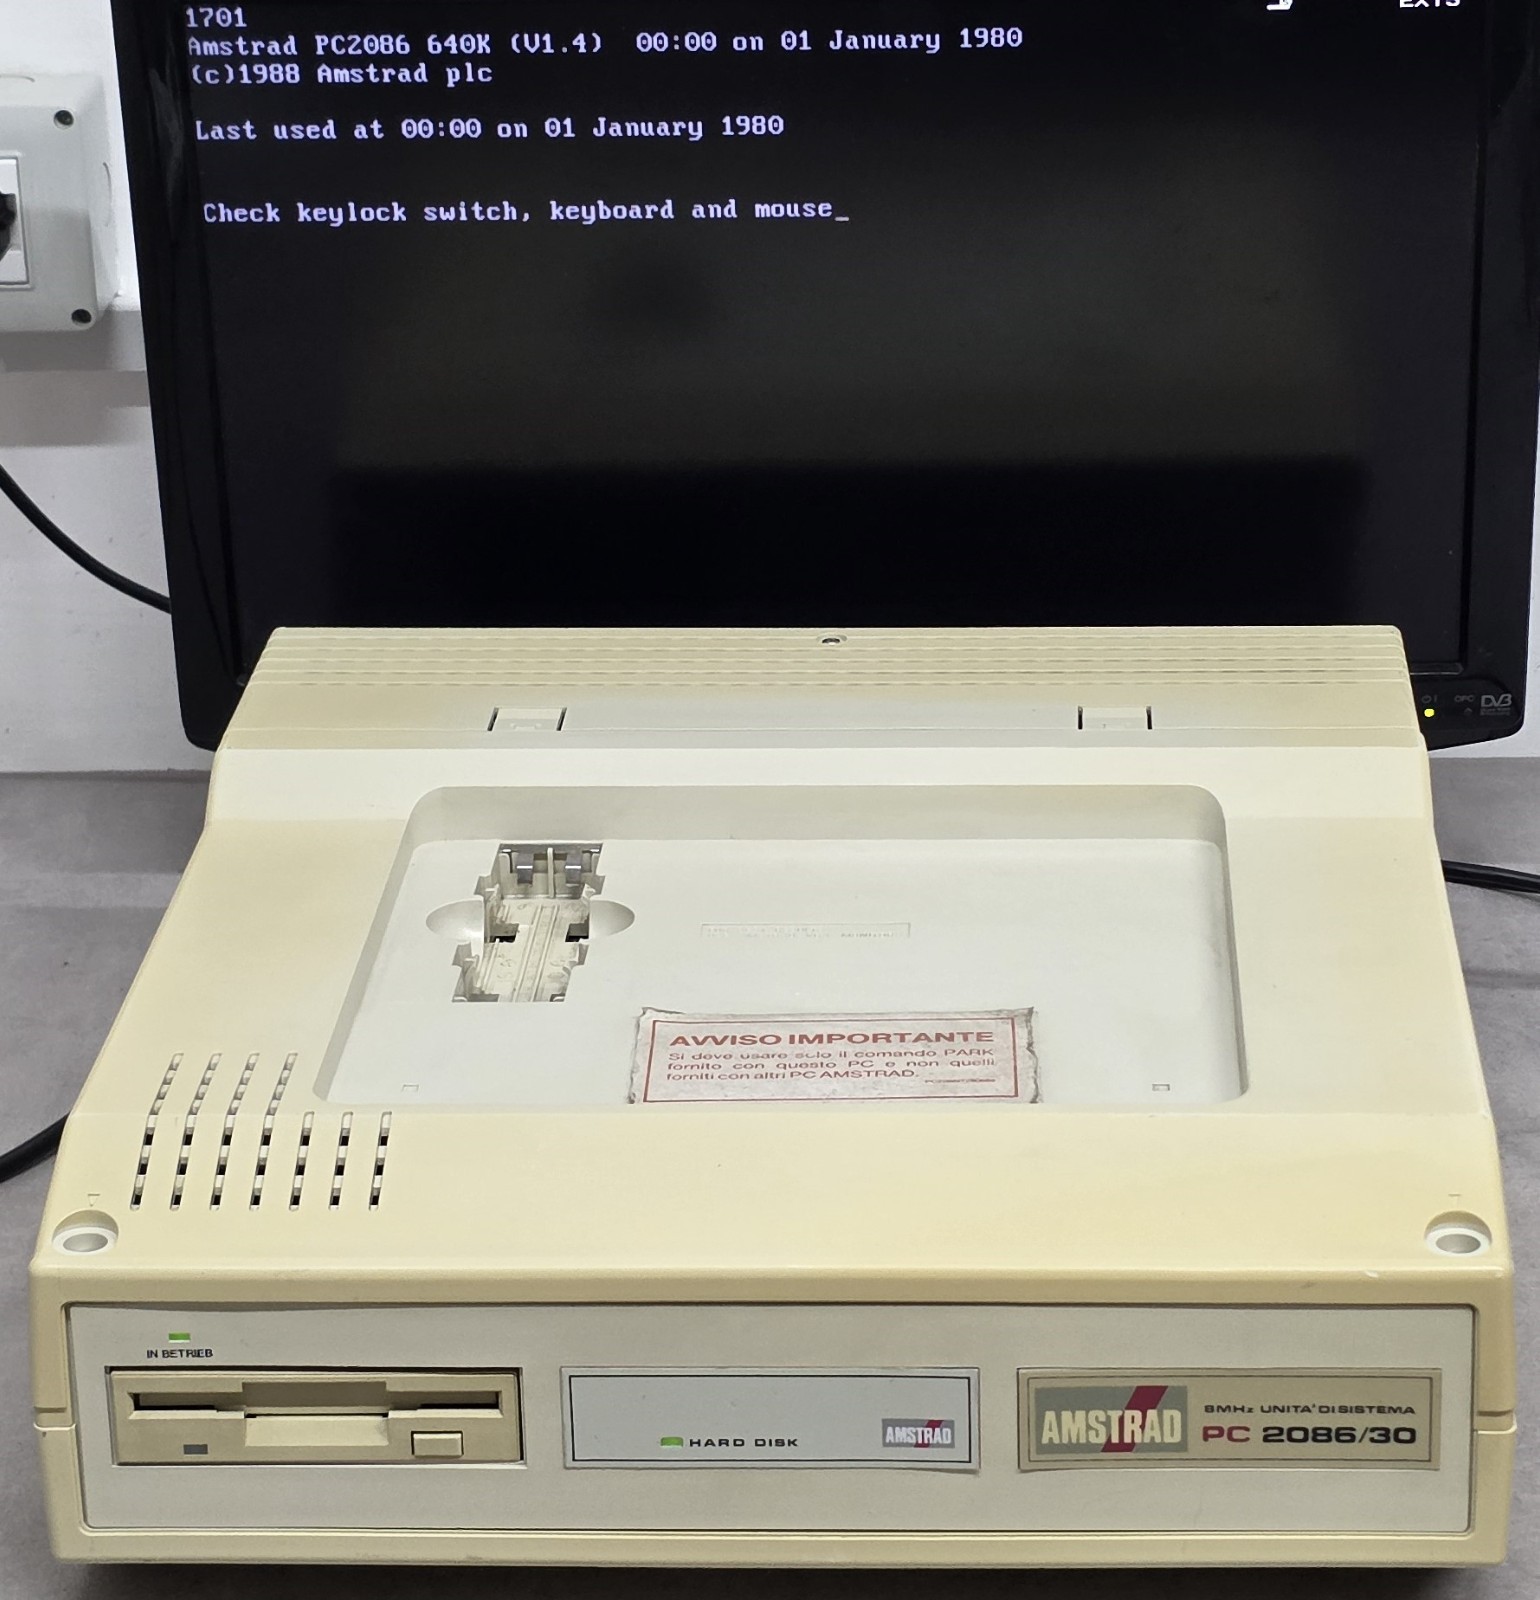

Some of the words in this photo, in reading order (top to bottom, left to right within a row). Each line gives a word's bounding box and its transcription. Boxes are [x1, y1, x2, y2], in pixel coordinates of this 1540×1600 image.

[186, 7, 247, 28] 1701
[188, 34, 298, 56] Amstrad
[314, 34, 410, 55] PC2086
[427, 33, 491, 55] 640K
[511, 32, 602, 54] (V1.4)
[636, 31, 717, 53] 00:00
[732, 36, 764, 51] on
[780, 30, 812, 51] 01
[829, 29, 940, 54] January
[960, 27, 1023, 48] 1980
[192, 63, 300, 84] (c)1988
[317, 62, 428, 84] Amstrad
[445, 61, 493, 88] plc
[195, 120, 257, 140] Last
[273, 119, 337, 140] used
[353, 119, 385, 139] at
[401, 118, 482, 139] 00:00
[497, 123, 528, 138] on
[544, 117, 576, 138] 01
[592, 116, 703, 142] January
[722, 115, 784, 136] 1980
[203, 202, 281, 223] Check
[296, 201, 407, 227] keylock
[423, 200, 530, 222] switch,
[549, 199, 675, 225] keyboard
[691, 198, 738, 219] and
[1481, 694, 1512, 708] DVB
[669, 1034, 783, 1047] AVVISO
[788, 1031, 995, 1046] IMPORTANTE
[668, 1052, 685, 1062] Si
[691, 1052, 734, 1061] deve
[739, 1052, 789, 1060] usare
[853, 1049, 937, 1059] comando
[943, 1048, 994, 1057] PARK
[667, 1062, 723, 1071] fornito
[732, 1062, 765, 1070] con
[775, 1061, 837, 1071] questo
[847, 1059, 875, 1069] PC
[905, 1060, 940, 1068] non
[949, 1057, 997, 1068] quelli
[666, 1072, 715, 1081] forniti
[717, 1072, 750, 1081] con
[753, 1071, 786, 1080] altri
[789, 1070, 817, 1081] PC
[819, 1068, 920, 1079] AMSTRAD.
[146, 1349, 159, 1359] IN
[161, 1348, 214, 1359] BETRIEB
[1204, 1404, 1254, 1414] 8MHz
[884, 1425, 953, 1446] AMSTRAD
[1041, 1410, 1182, 1444] AMSTRAD
[1202, 1425, 1251, 1443] PC
[1262, 1426, 1417, 1444] 2086/30
[689, 1438, 746, 1448] HARD
[754, 1438, 799, 1448] DISK
